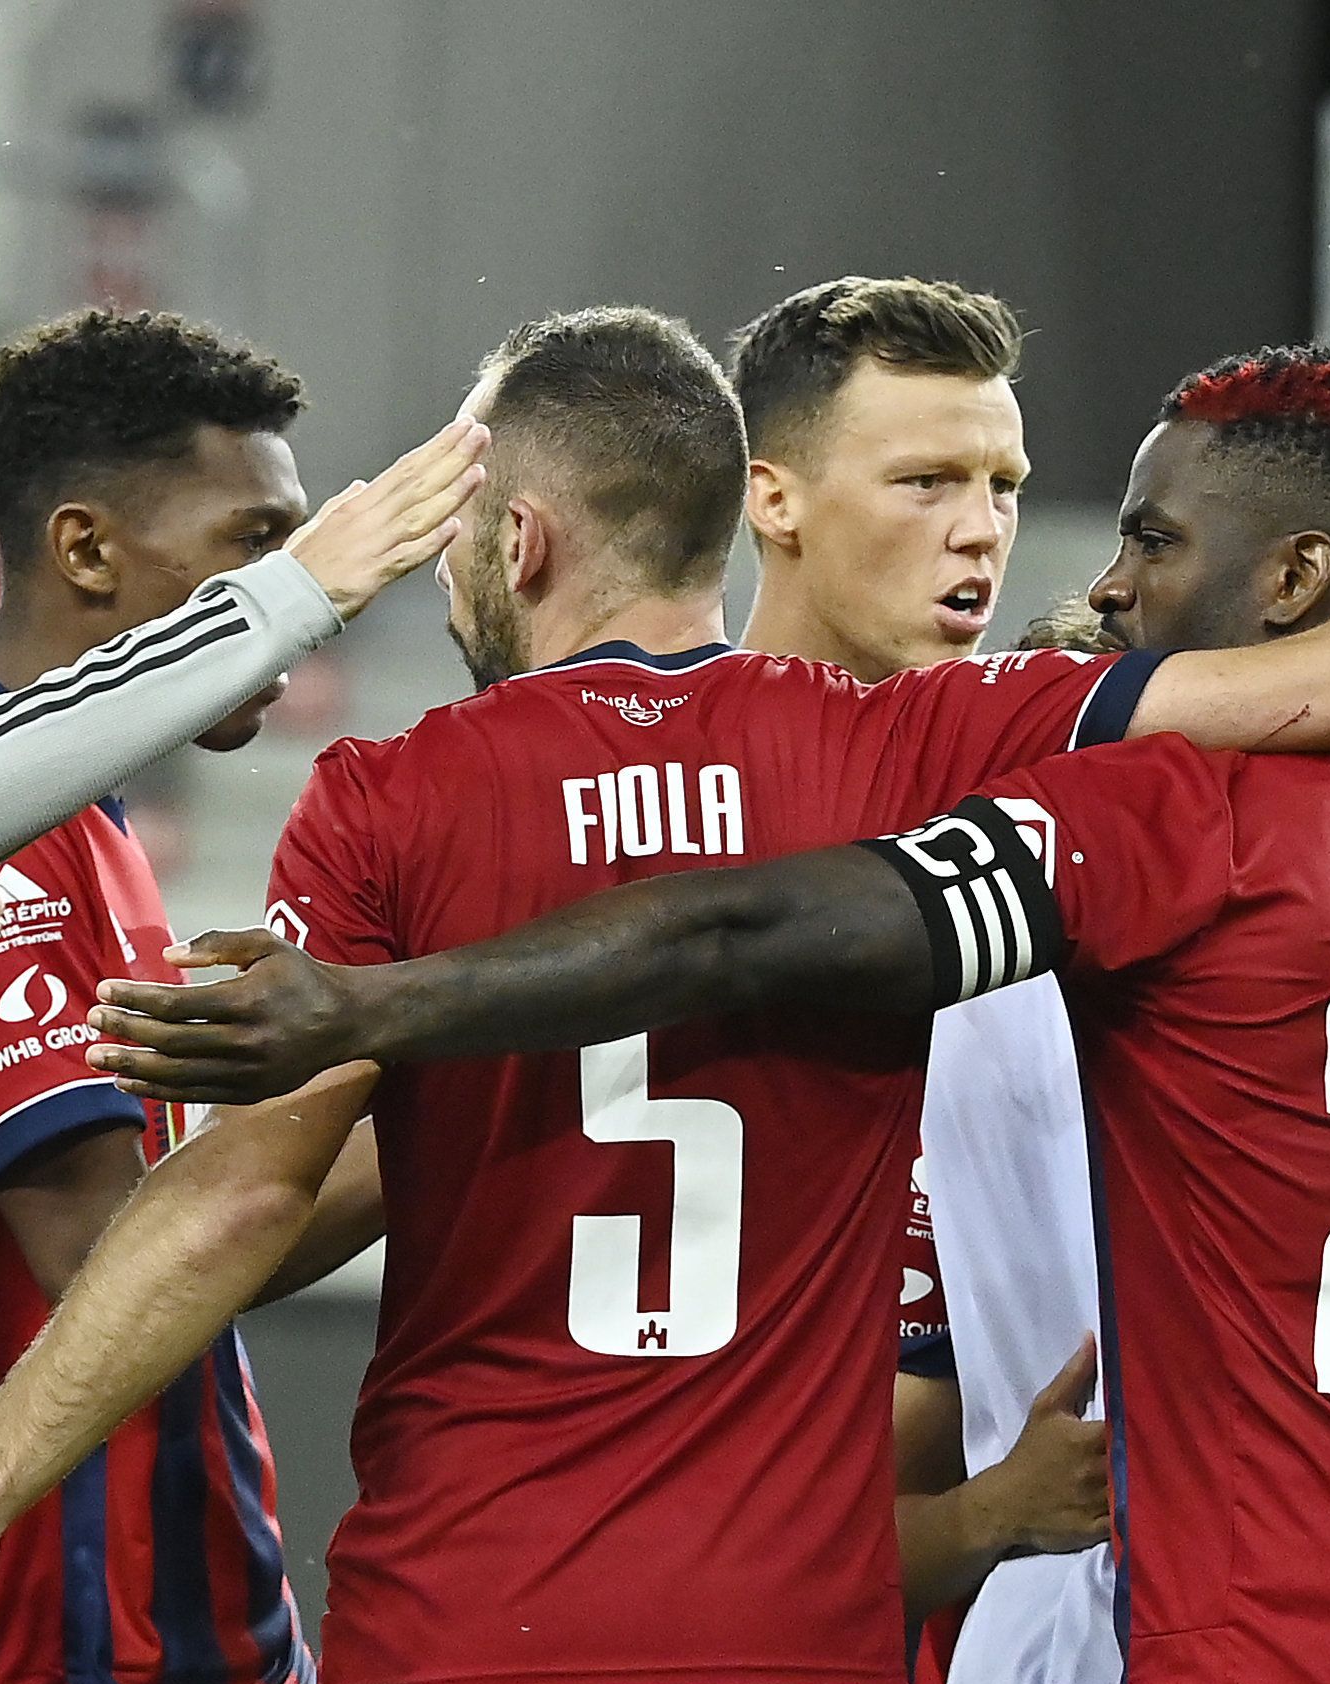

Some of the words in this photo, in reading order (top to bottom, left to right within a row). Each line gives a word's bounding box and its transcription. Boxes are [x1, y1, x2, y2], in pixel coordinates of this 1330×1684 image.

[562, 761, 746, 866] FIOLA
[45, 1023, 101, 1050] GROU
[568, 1031, 744, 1358] 5
